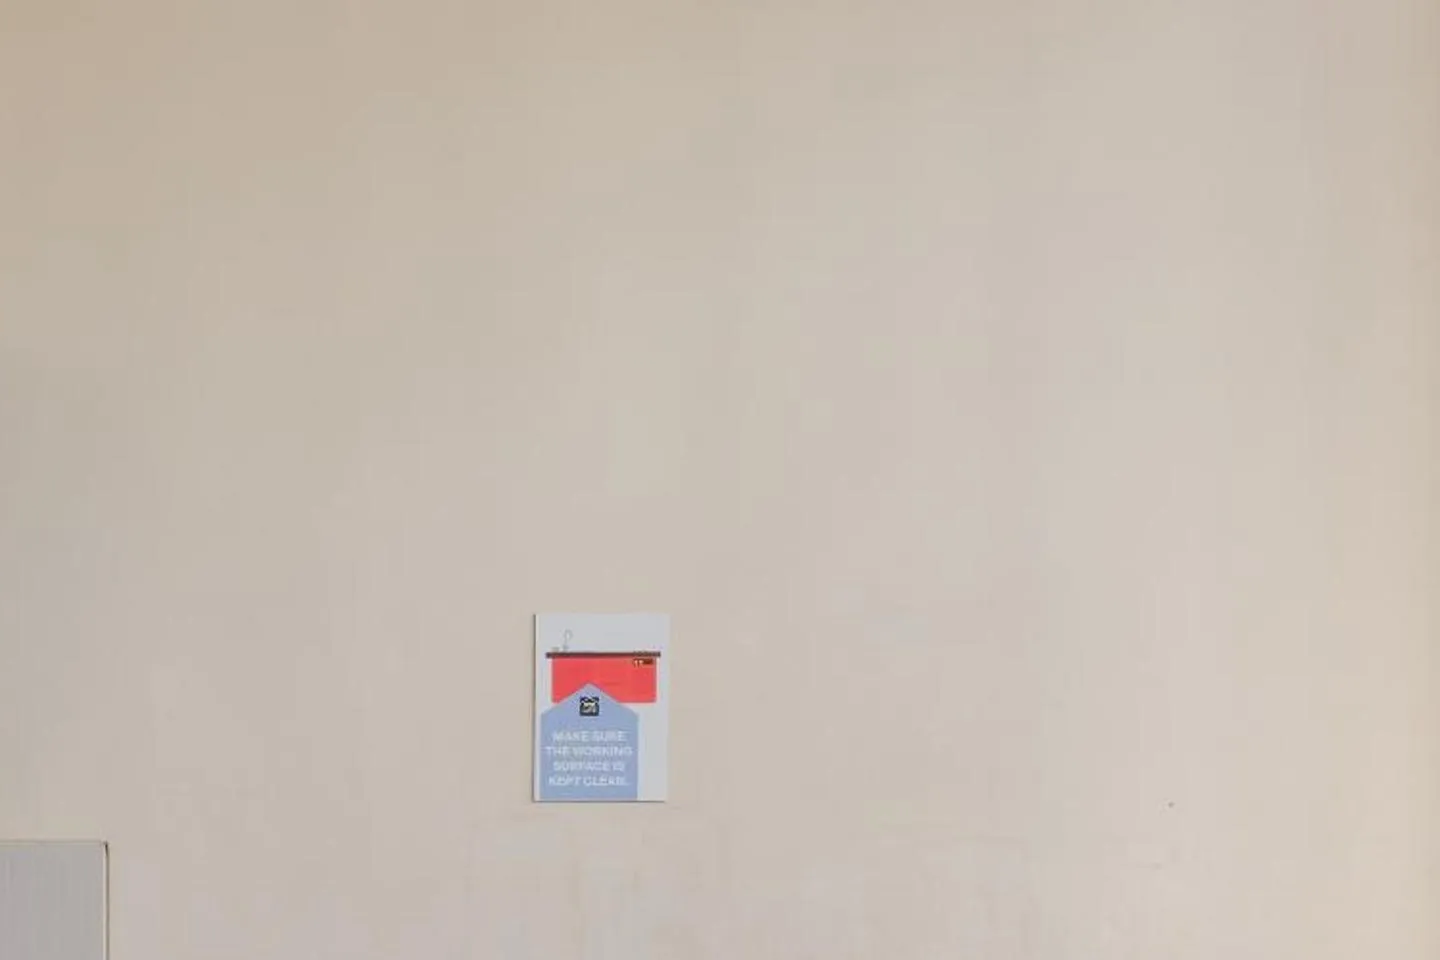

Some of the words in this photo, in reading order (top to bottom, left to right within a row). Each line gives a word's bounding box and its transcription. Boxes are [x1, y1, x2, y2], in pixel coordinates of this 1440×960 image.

[553, 730, 589, 742] MAKE
[546, 746, 570, 757] THE
[571, 746, 633, 757] WORKING
[553, 761, 610, 771] SURFACE
[611, 761, 625, 771] IS
[548, 776, 581, 787] KEPT
